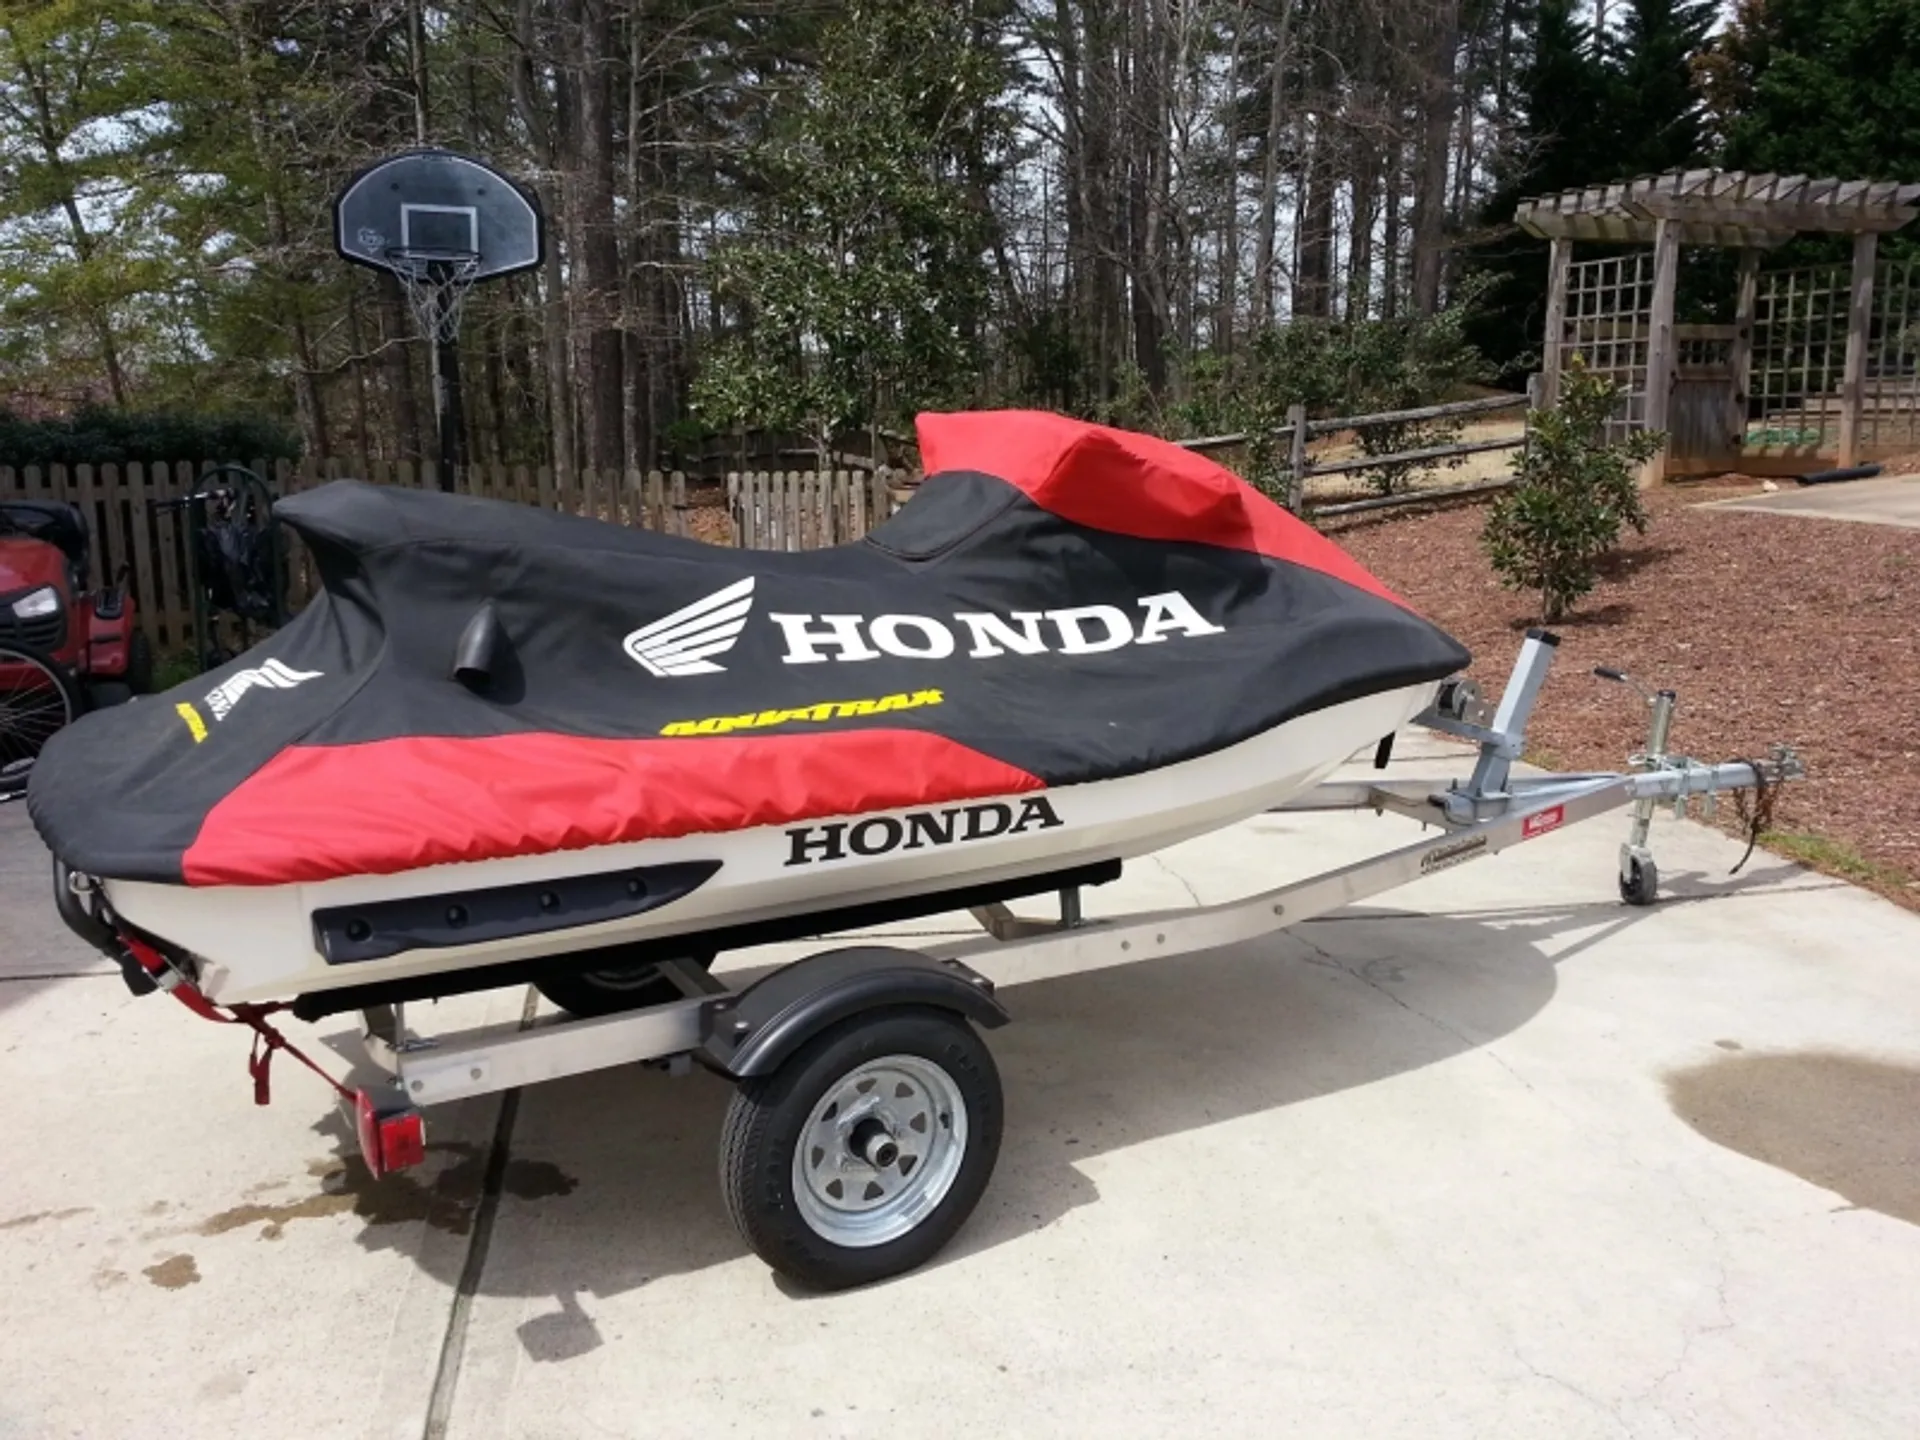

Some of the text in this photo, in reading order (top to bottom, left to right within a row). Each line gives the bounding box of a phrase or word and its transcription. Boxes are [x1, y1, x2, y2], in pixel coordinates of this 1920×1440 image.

[769, 591, 1226, 665] HONDA
[660, 689, 944, 737] AQUATRAX
[783, 796, 1064, 866] HONDA
